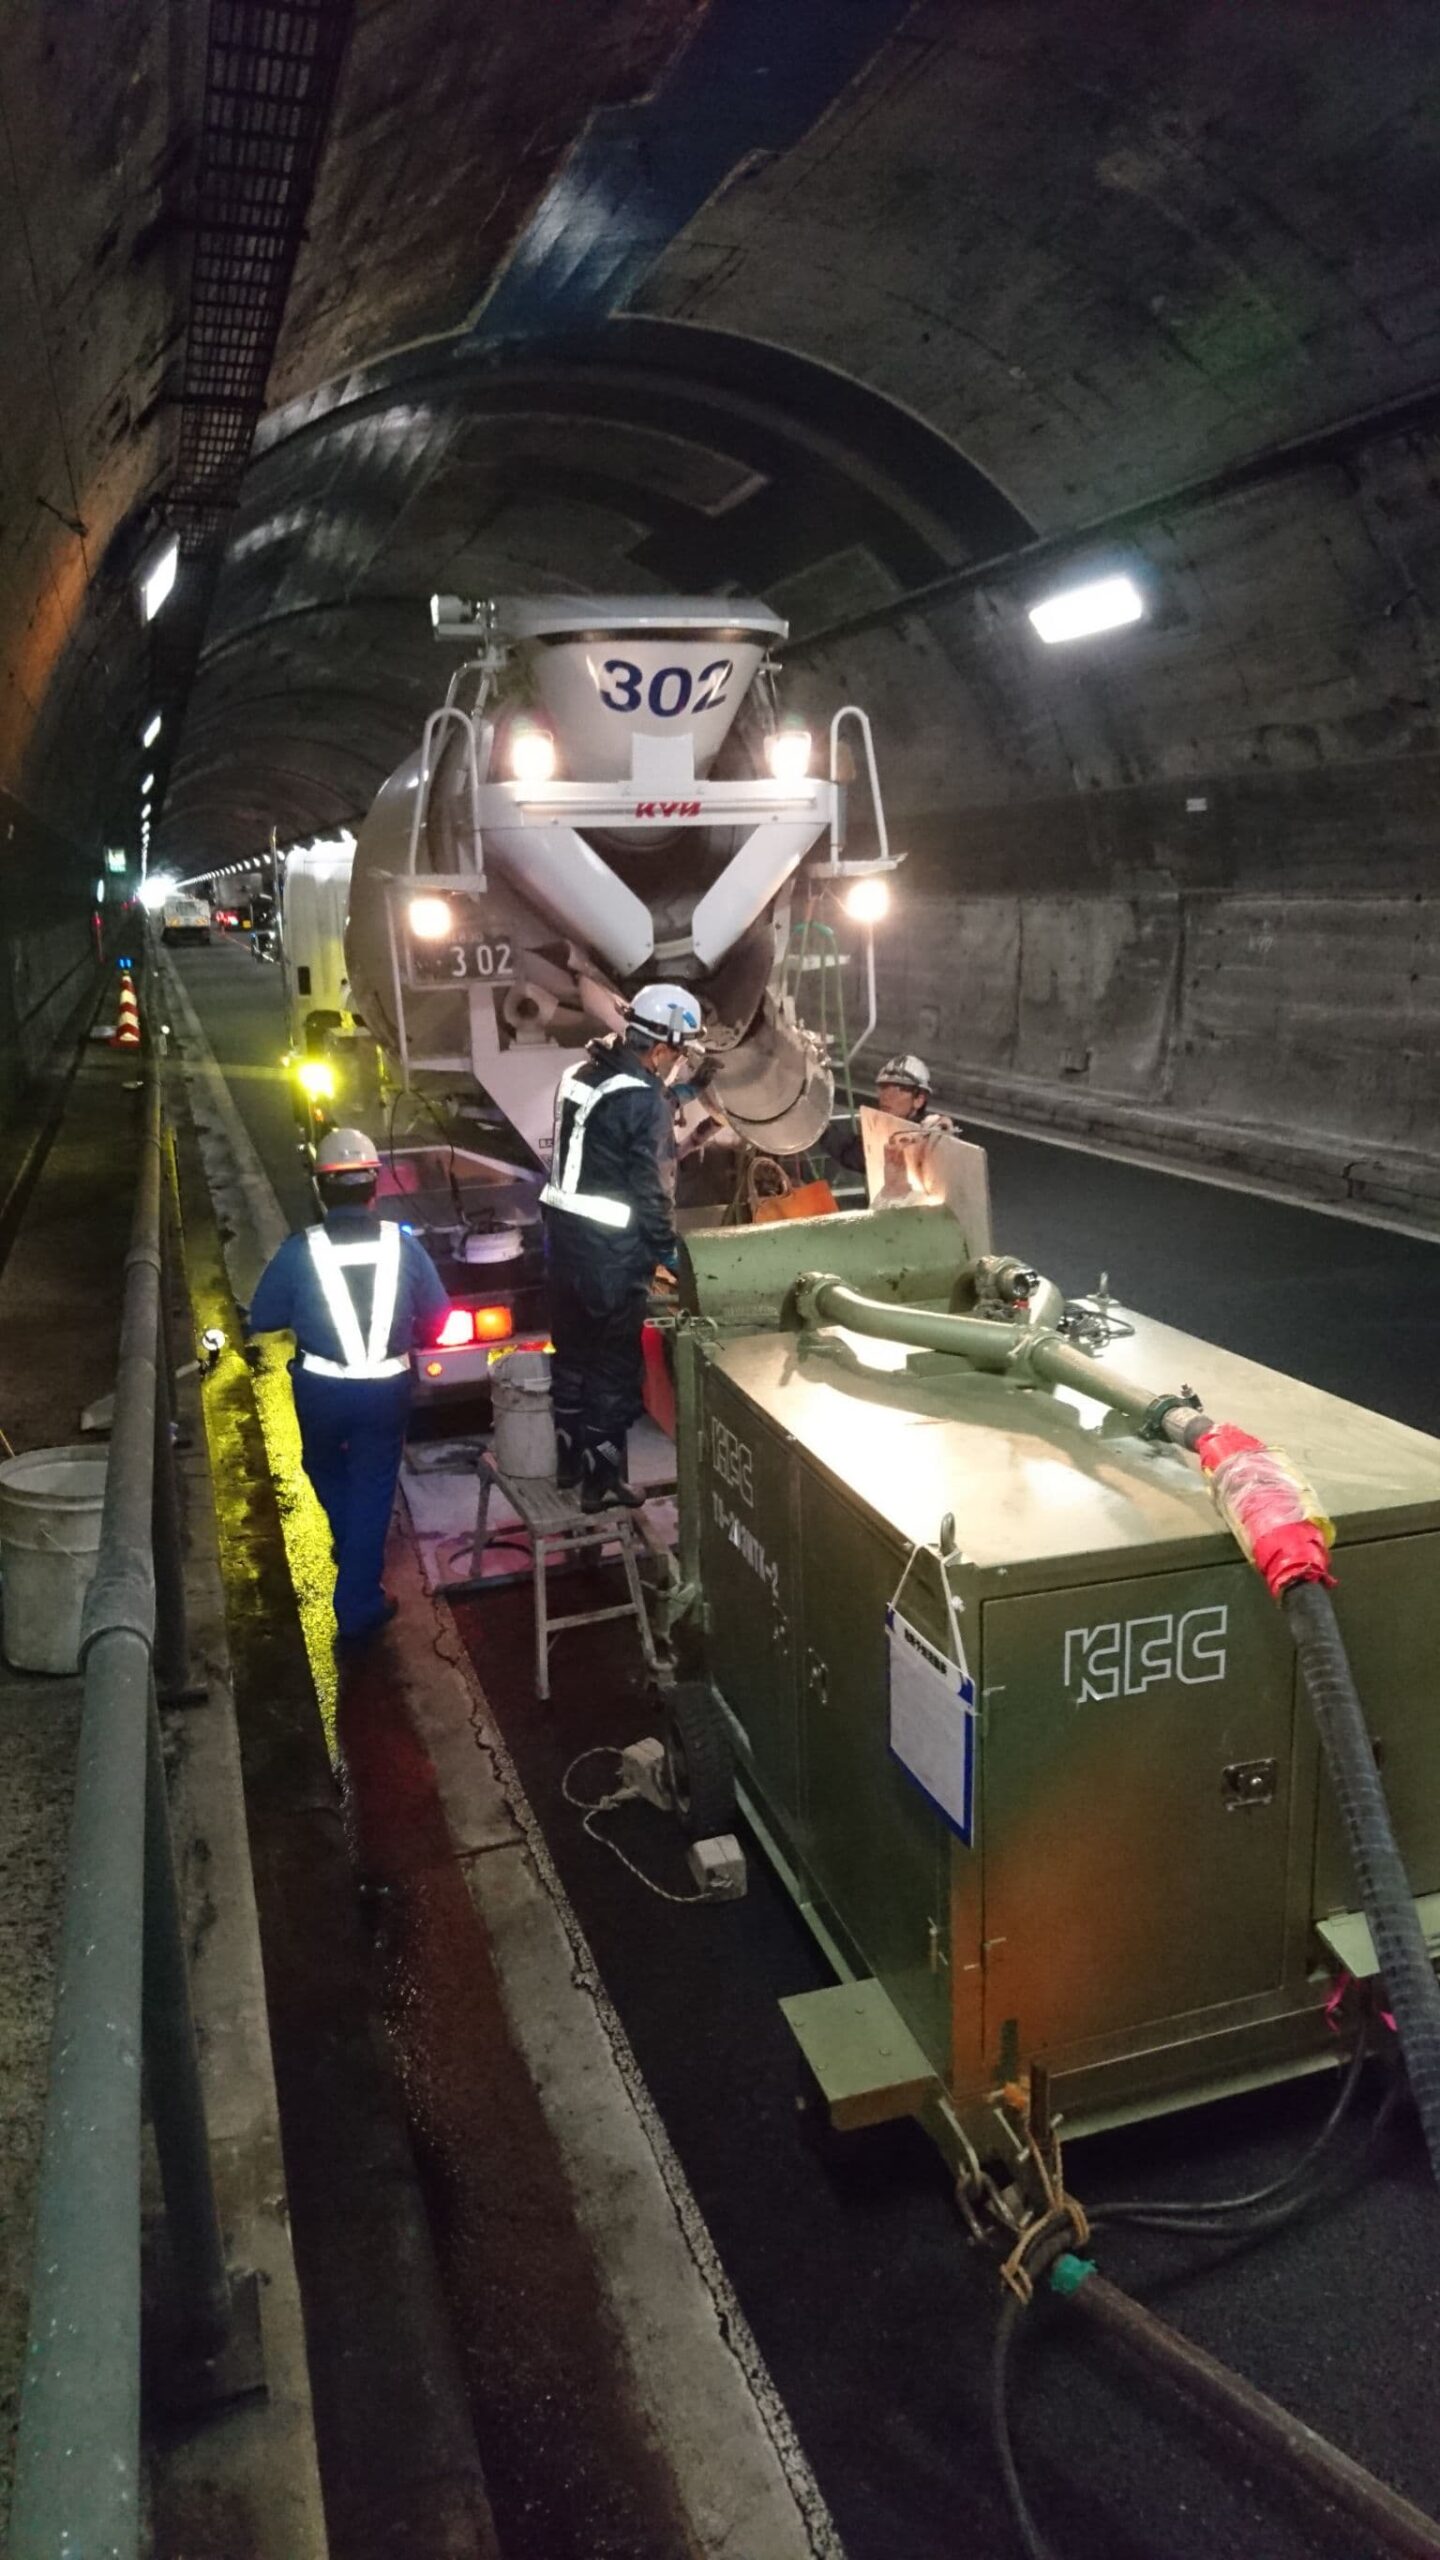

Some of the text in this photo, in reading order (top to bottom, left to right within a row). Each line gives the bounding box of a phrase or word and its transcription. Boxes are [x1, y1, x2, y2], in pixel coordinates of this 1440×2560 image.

[600, 659, 734, 718] 302
[634, 802, 702, 818] KYB
[1064, 1605, 1228, 1704] KFC
